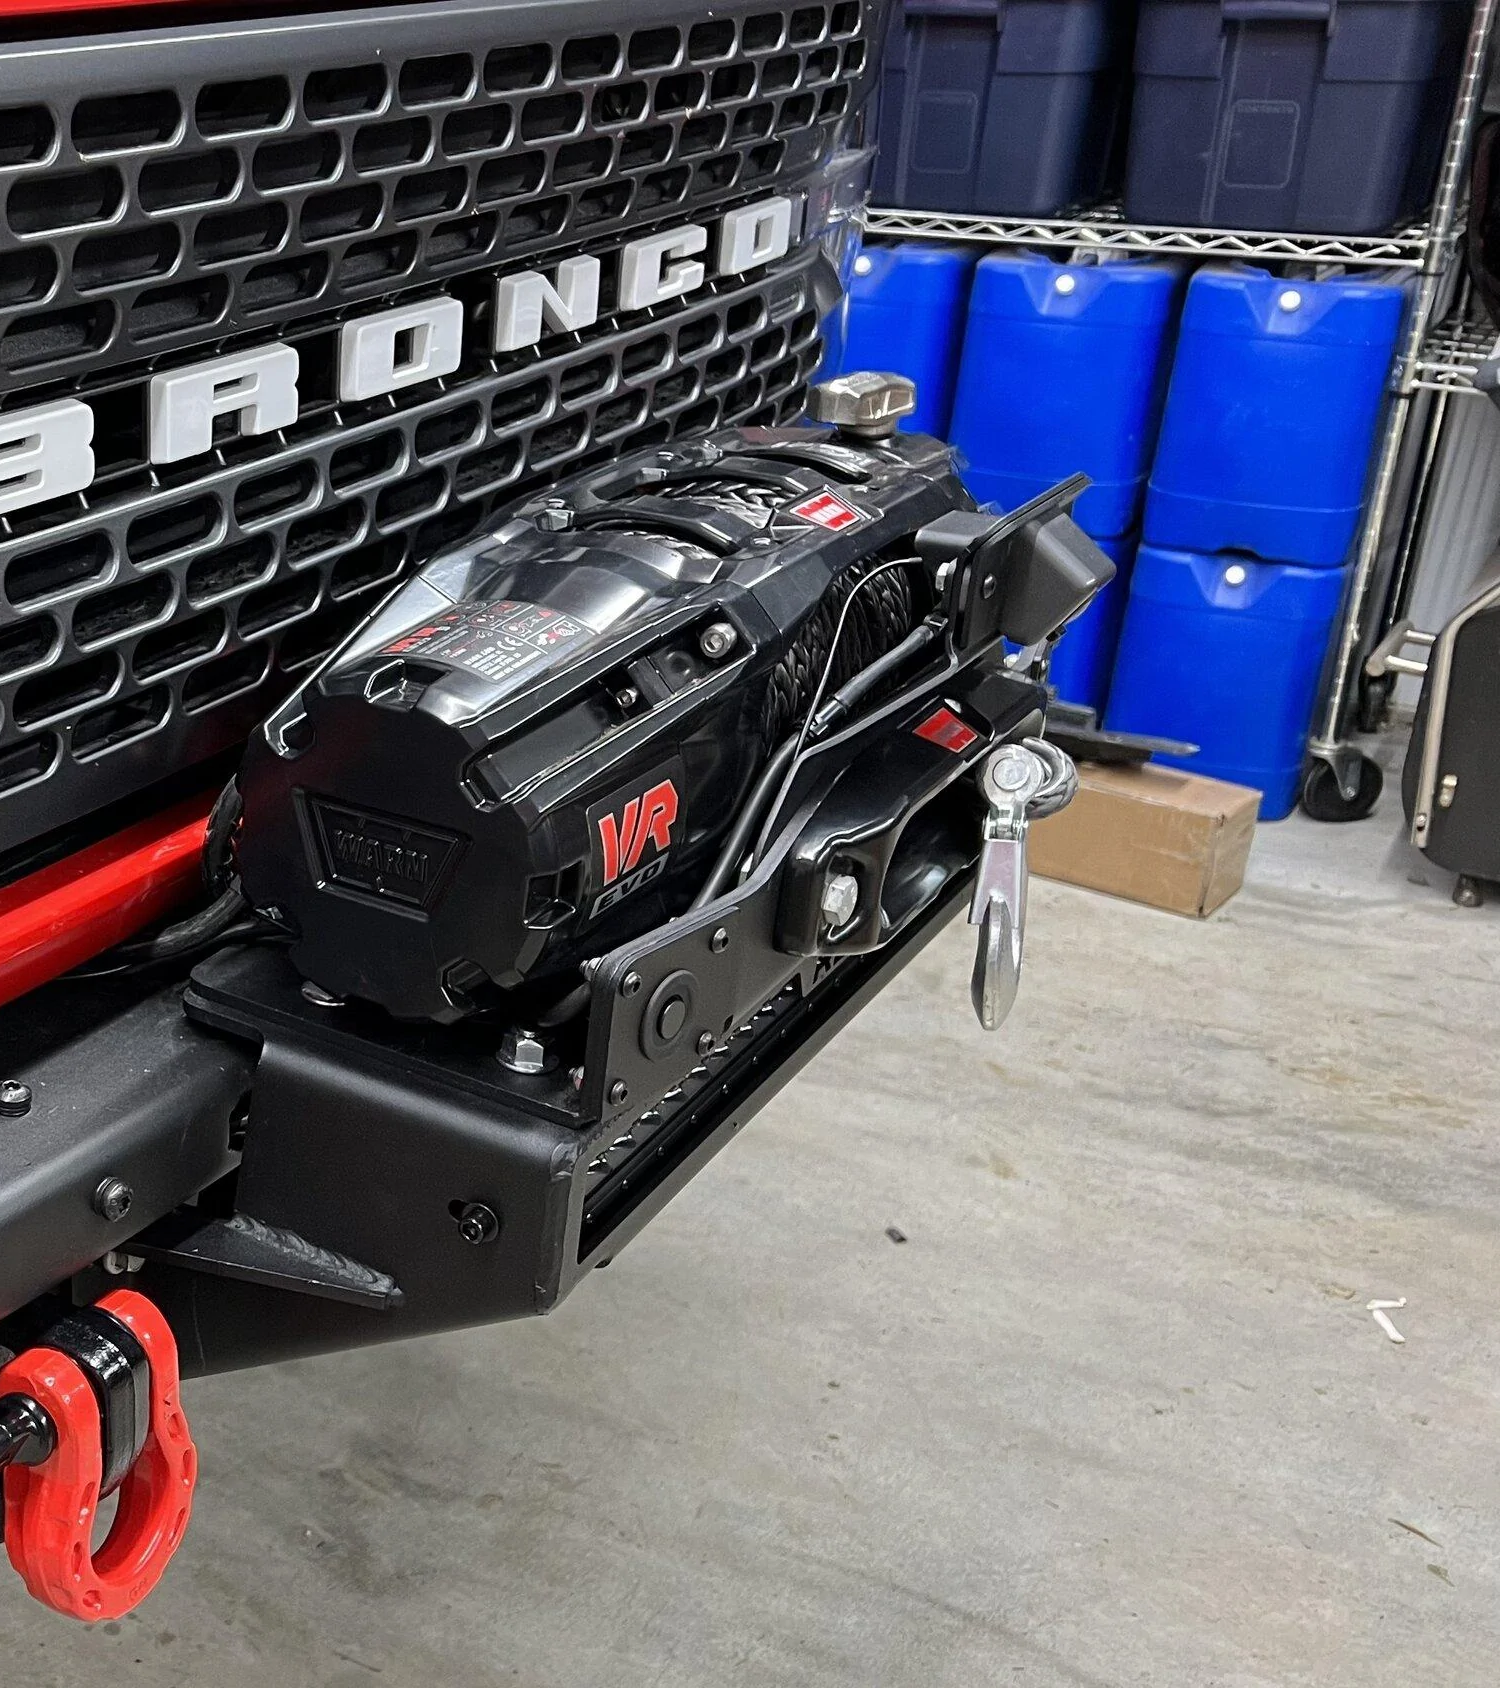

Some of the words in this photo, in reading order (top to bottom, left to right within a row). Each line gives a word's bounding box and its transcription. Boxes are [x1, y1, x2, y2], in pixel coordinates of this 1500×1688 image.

[334, 829, 429, 884] WARN
[598, 778, 678, 886] VR
[594, 859, 663, 915] EVO
